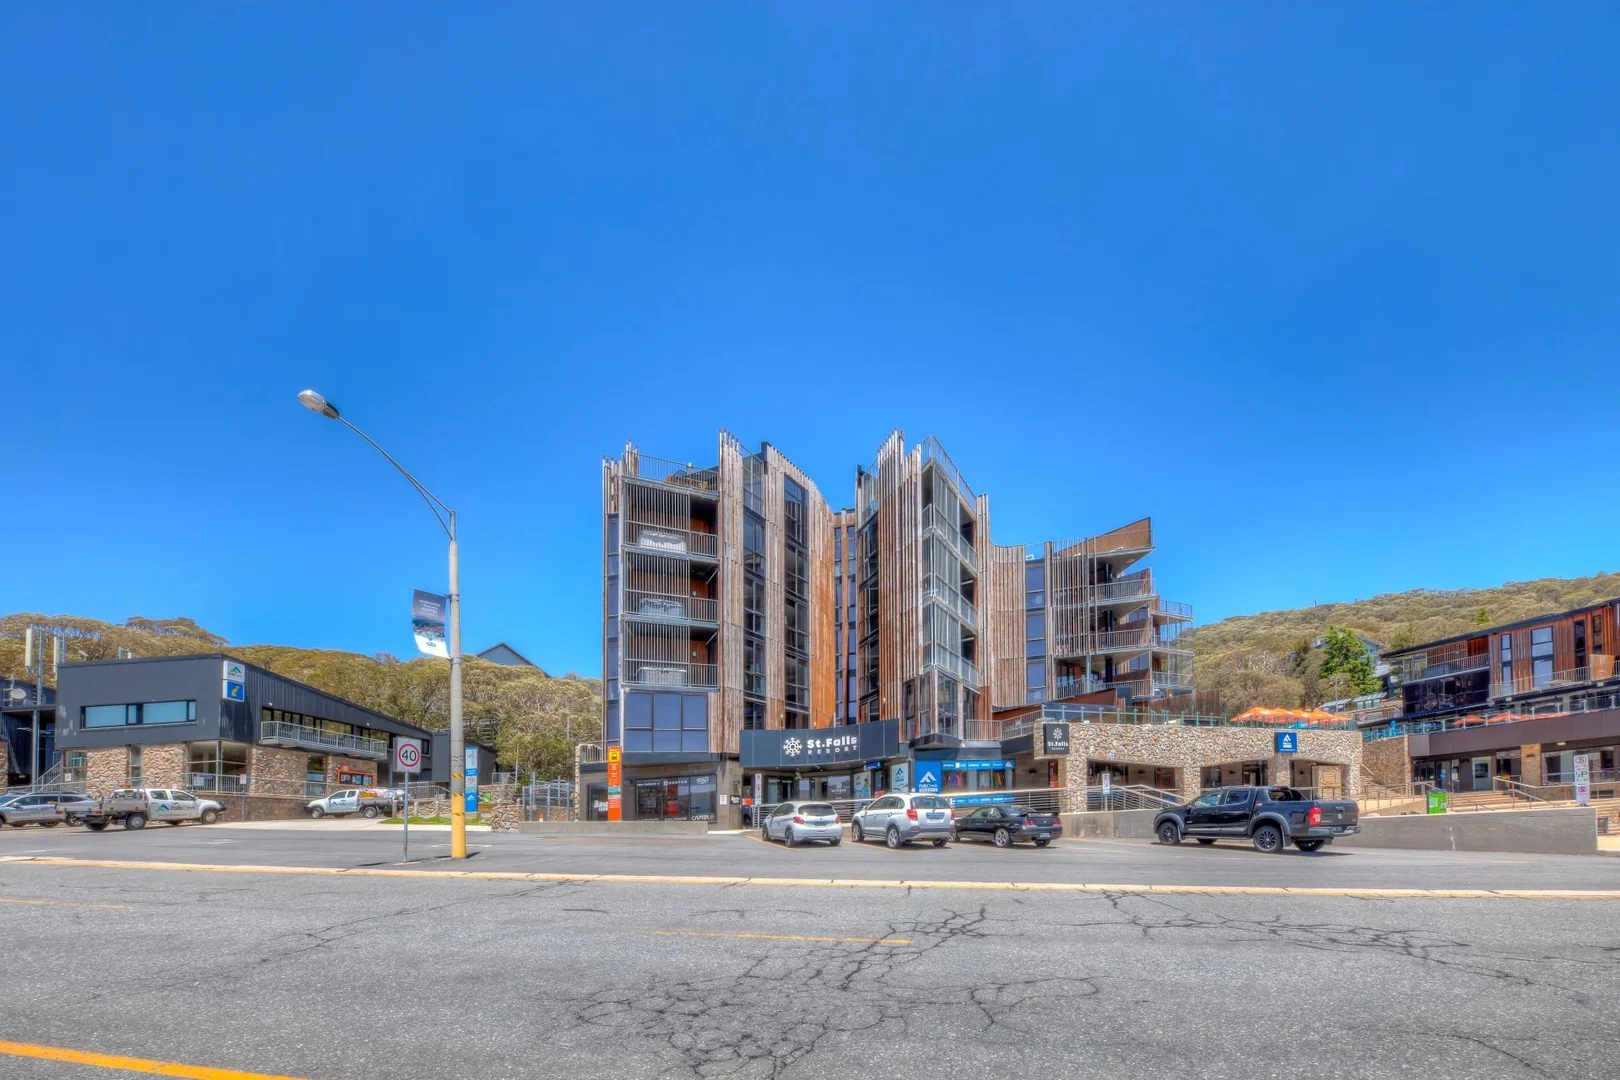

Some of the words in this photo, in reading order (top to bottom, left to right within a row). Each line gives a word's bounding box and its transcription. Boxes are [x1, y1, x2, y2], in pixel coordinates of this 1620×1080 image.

[807, 736, 857, 749] St.Falls
[401, 749, 417, 762] 40
[808, 745, 857, 755] RESORT
